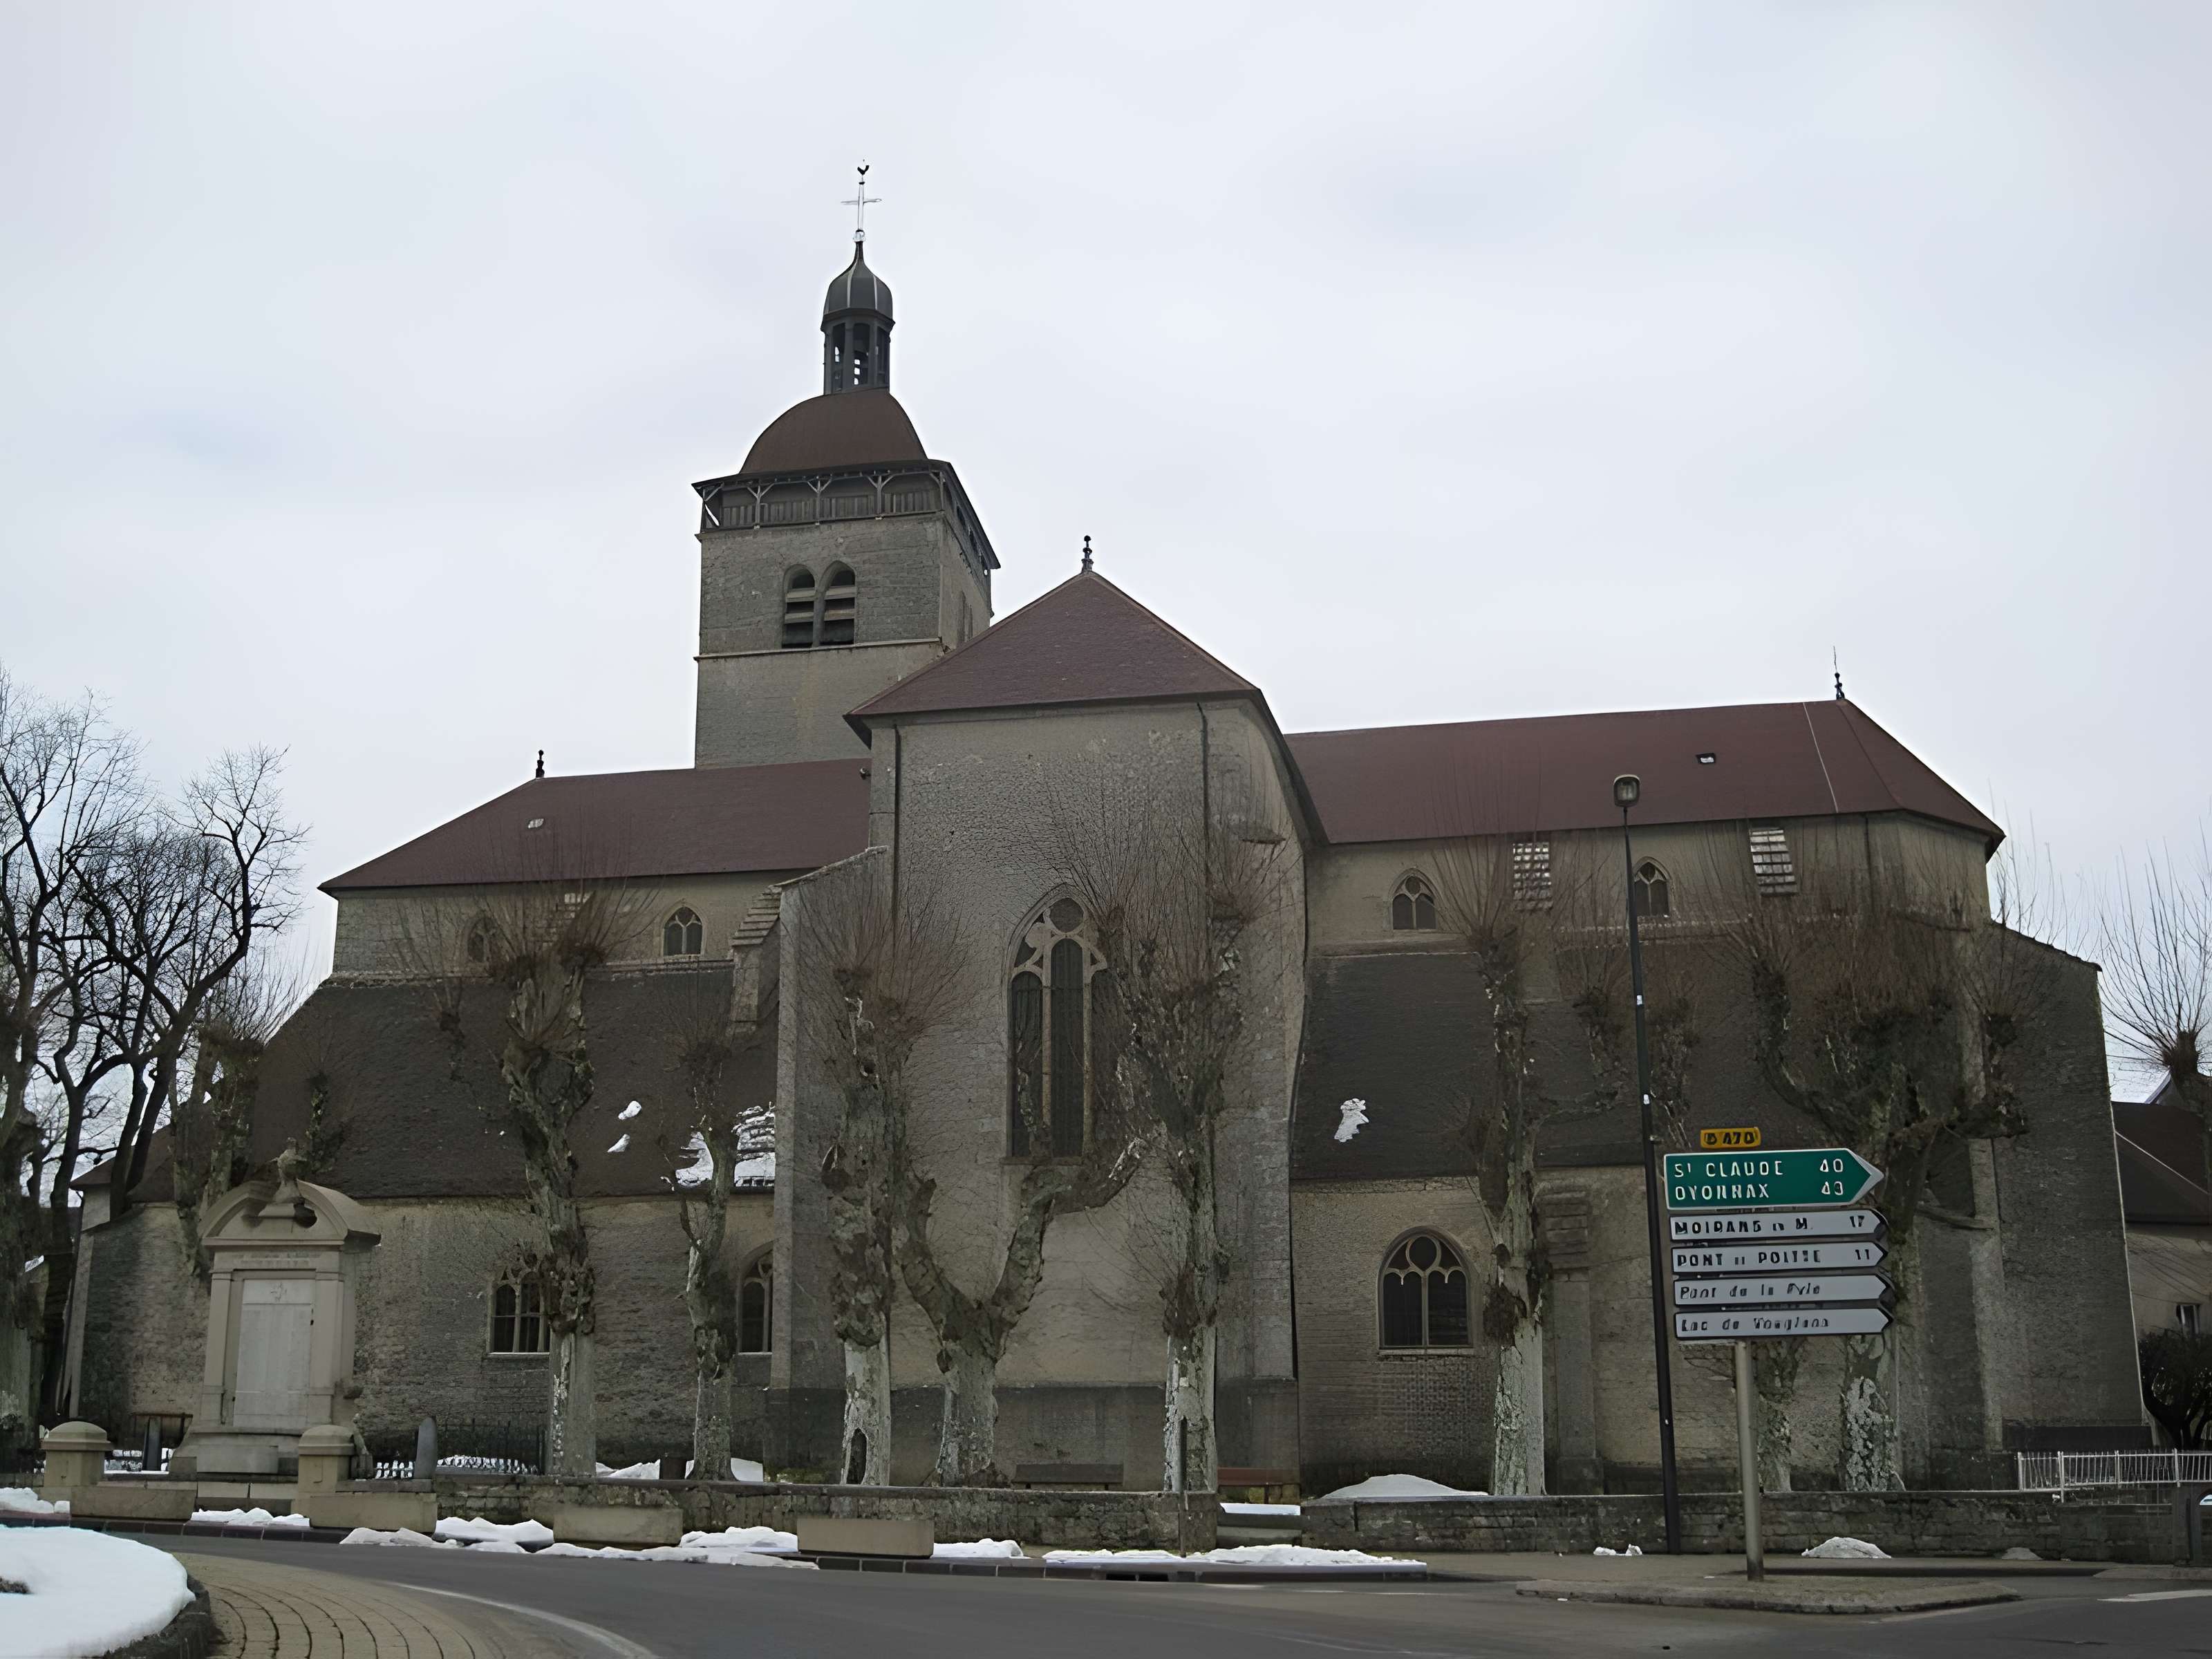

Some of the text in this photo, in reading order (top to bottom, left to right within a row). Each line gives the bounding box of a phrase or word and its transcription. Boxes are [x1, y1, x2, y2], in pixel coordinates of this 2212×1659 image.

[1706, 1161, 1783, 1177] CLAUDE
[1819, 1158, 1844, 1173] 40
[1675, 1183, 1770, 1201] OYONNAX
[1675, 1220, 1761, 1235] MOIRANS
[1677, 1253, 1723, 1266] PONT
[1855, 1249, 1870, 1260] 11
